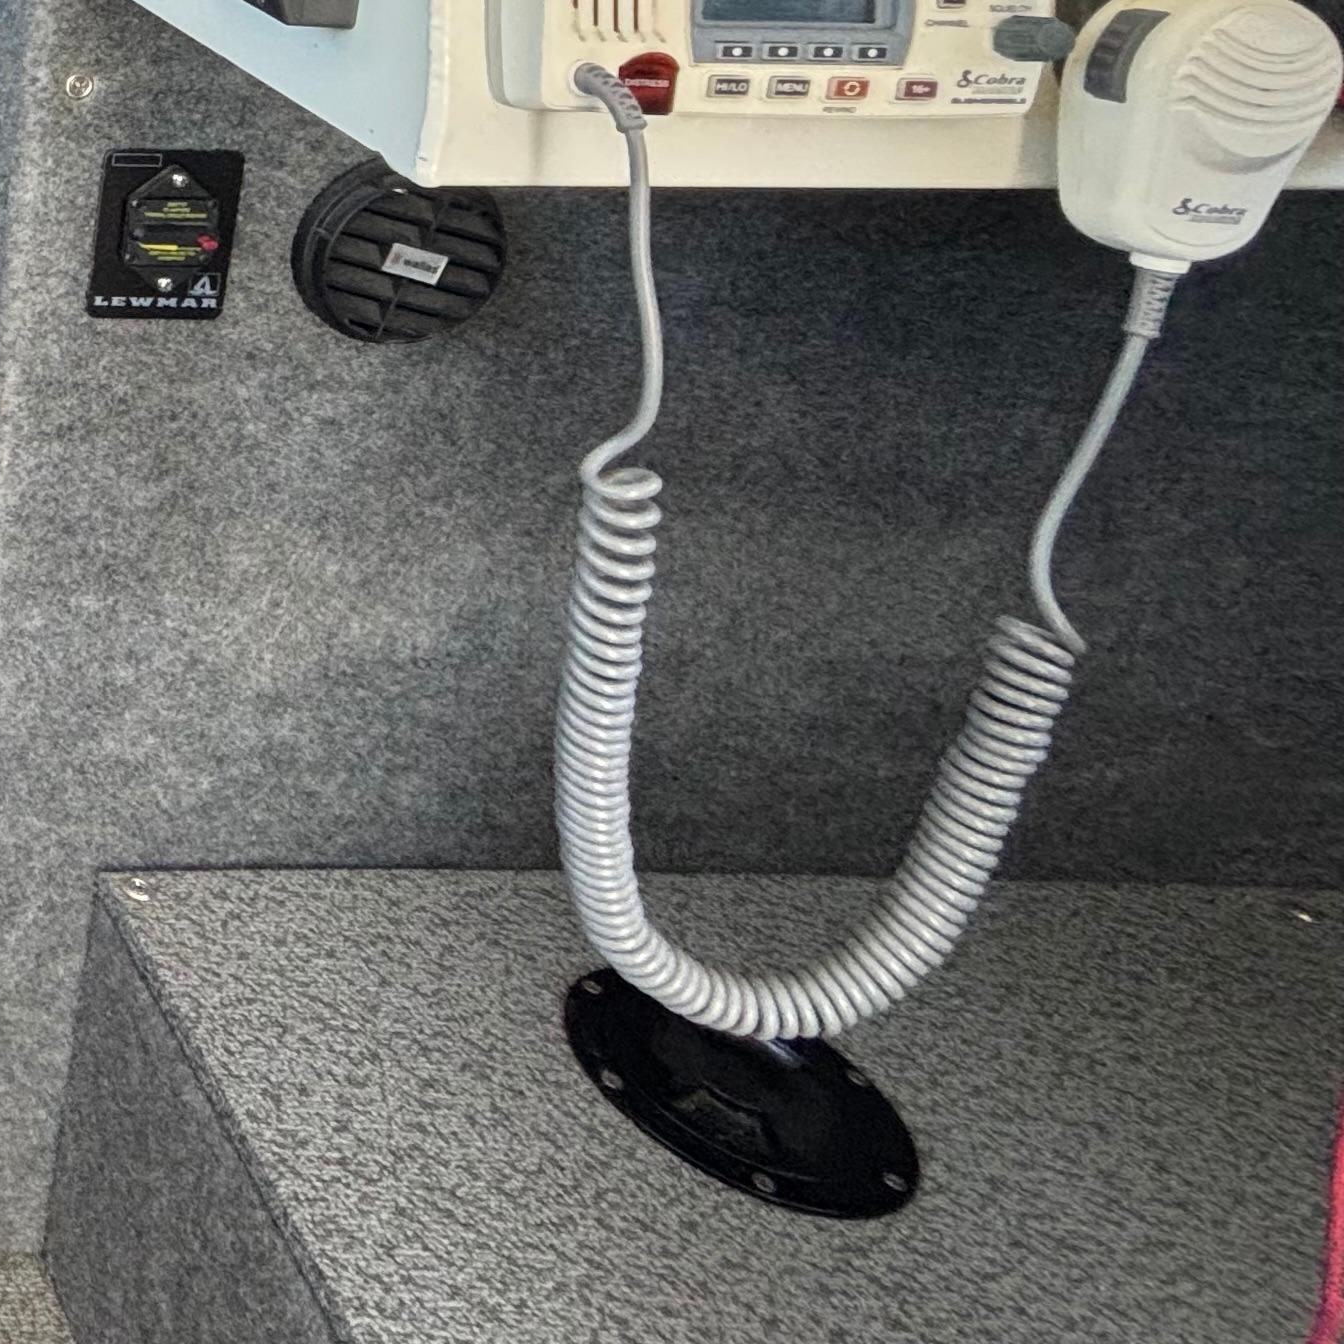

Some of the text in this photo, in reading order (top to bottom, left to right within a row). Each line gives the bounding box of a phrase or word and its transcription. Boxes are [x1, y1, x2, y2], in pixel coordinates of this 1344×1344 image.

[972, 73, 1027, 87] Cobra
[776, 82, 808, 93] MENU
[93, 296, 218, 308] LEWMAR
